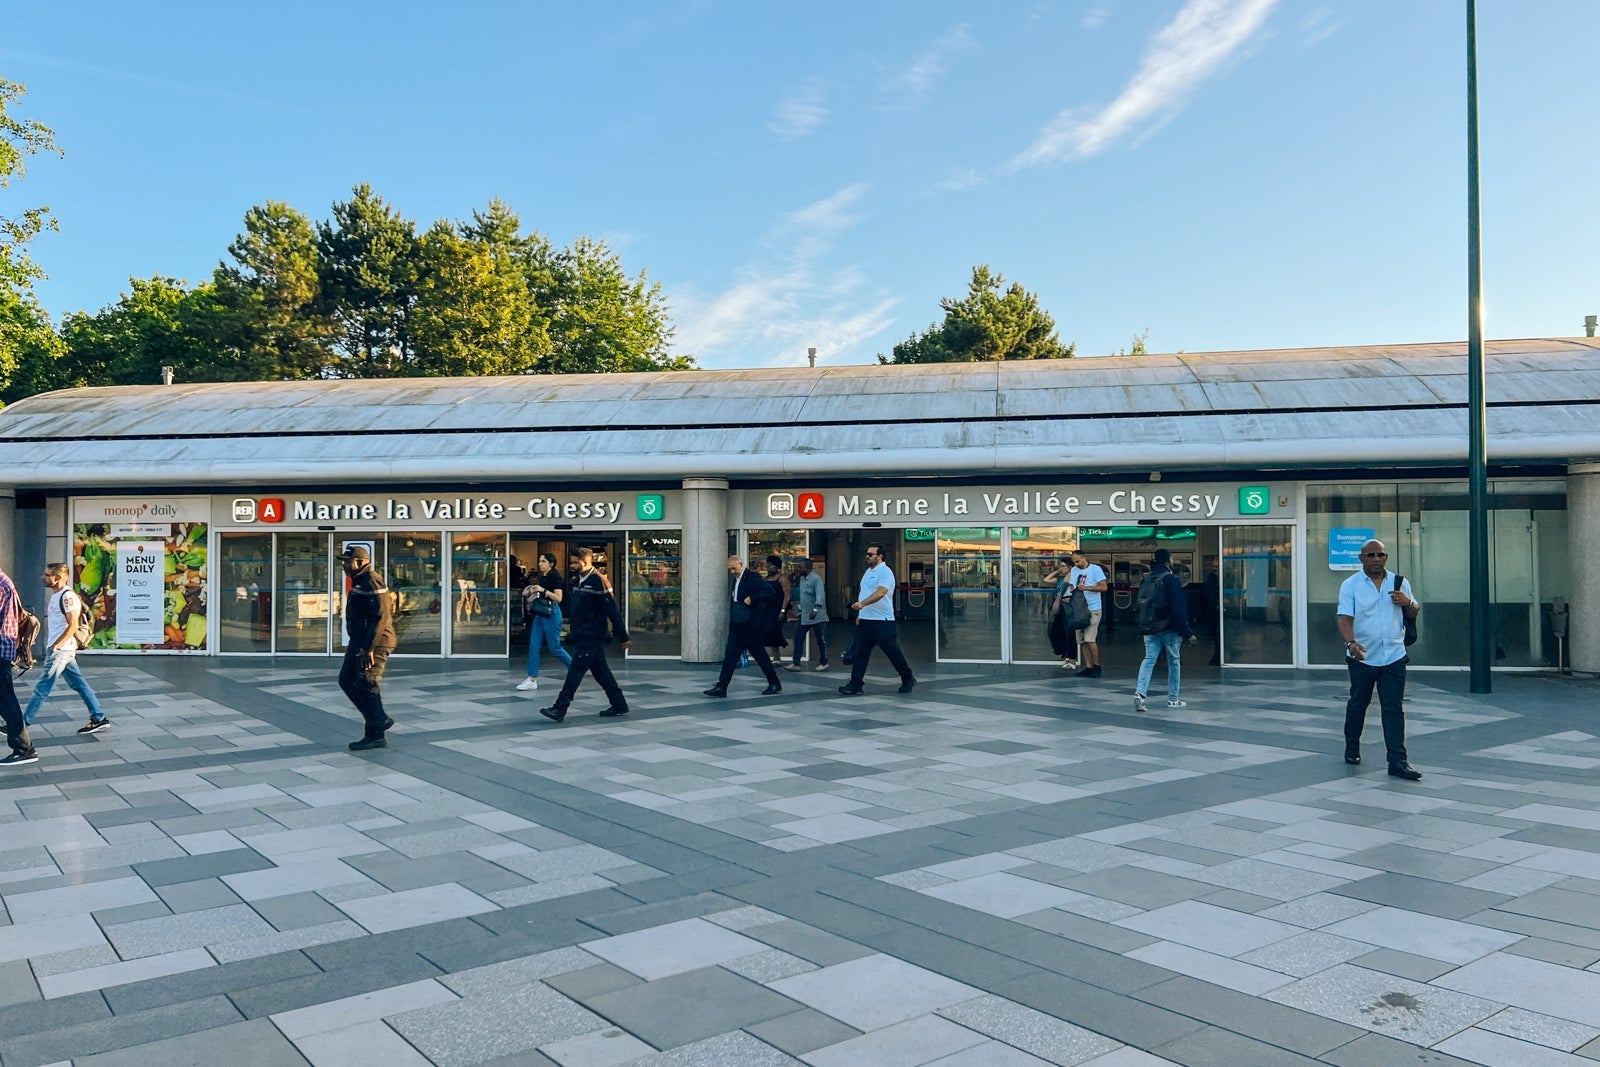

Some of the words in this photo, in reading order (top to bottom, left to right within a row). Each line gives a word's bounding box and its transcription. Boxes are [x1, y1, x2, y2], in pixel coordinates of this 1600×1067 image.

[151, 504, 178, 518] daily
[235, 506, 253, 516] RER
[263, 503, 276, 518] A
[294, 500, 377, 520] Marne
[386, 499, 411, 519] la
[772, 501, 790, 511] RER
[803, 498, 817, 513] A
[838, 495, 929, 516] Marne
[943, 493, 969, 515] la
[126, 555, 156, 564] MENU
[126, 564, 155, 573] DAILY
